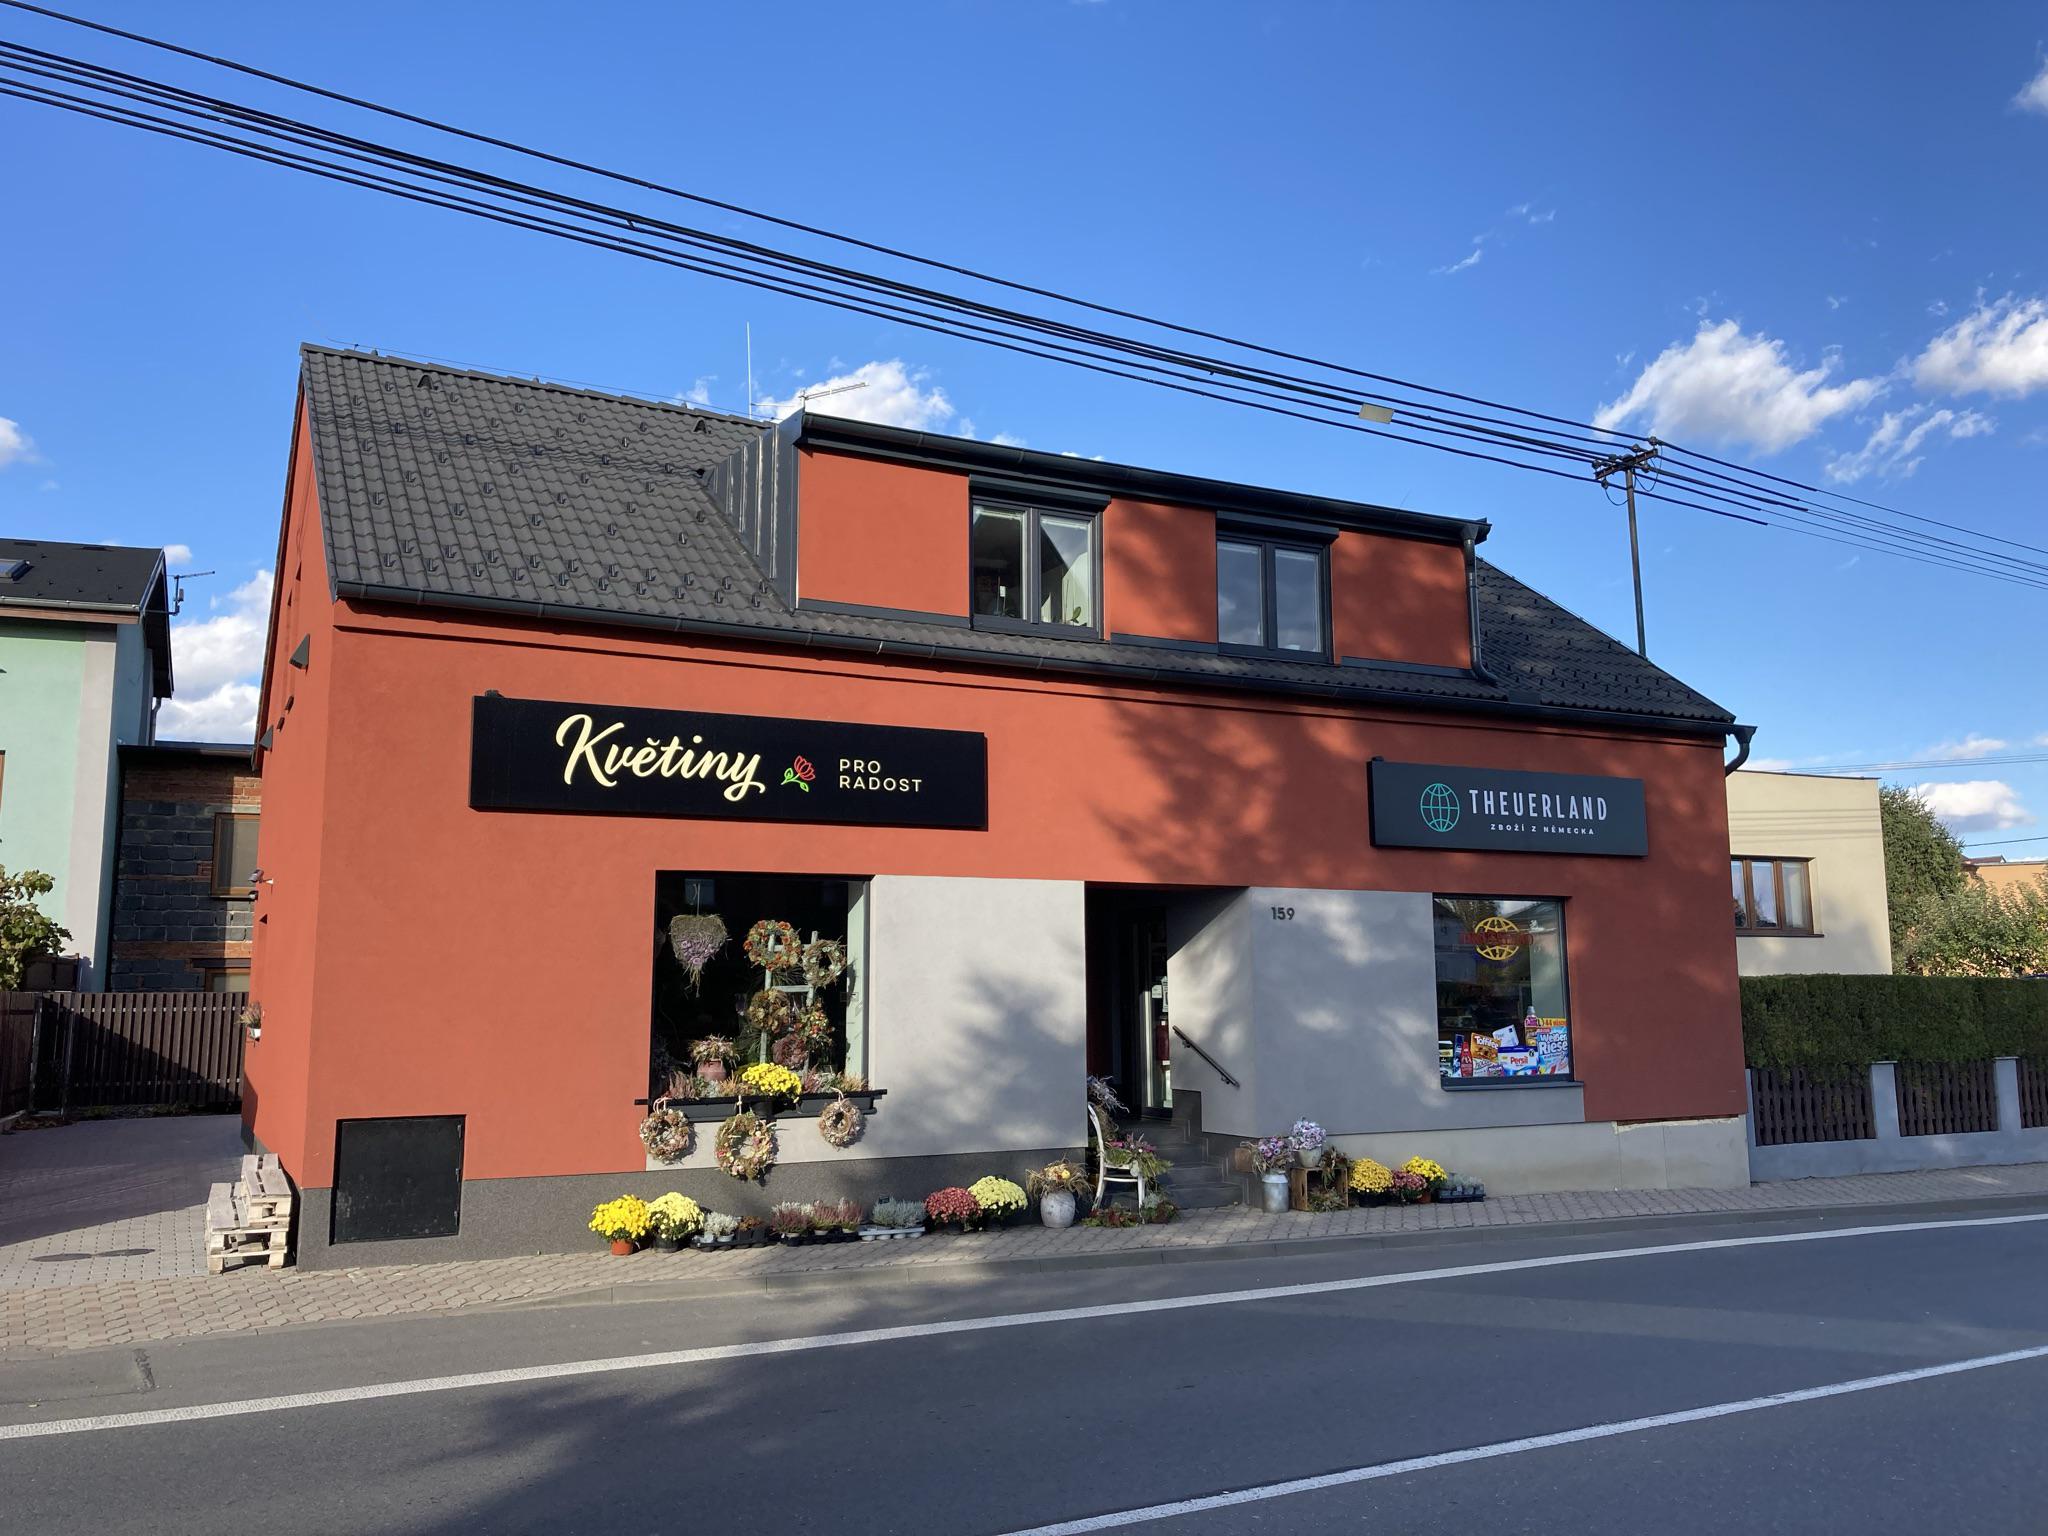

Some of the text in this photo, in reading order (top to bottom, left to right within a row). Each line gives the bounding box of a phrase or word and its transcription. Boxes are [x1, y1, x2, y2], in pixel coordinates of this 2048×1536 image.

[555, 713, 766, 802] Květiny
[839, 758, 882, 775] PRO
[838, 774, 923, 793] RADOST
[1469, 789, 1608, 821] THEUERLAND
[1490, 822, 1526, 832] ZBOŽÍ
[1543, 824, 1595, 835] NĚMECKA
[1271, 906, 1295, 920] 159
[1538, 1041, 1568, 1056] Riese
[1510, 1056, 1528, 1064] Persil
